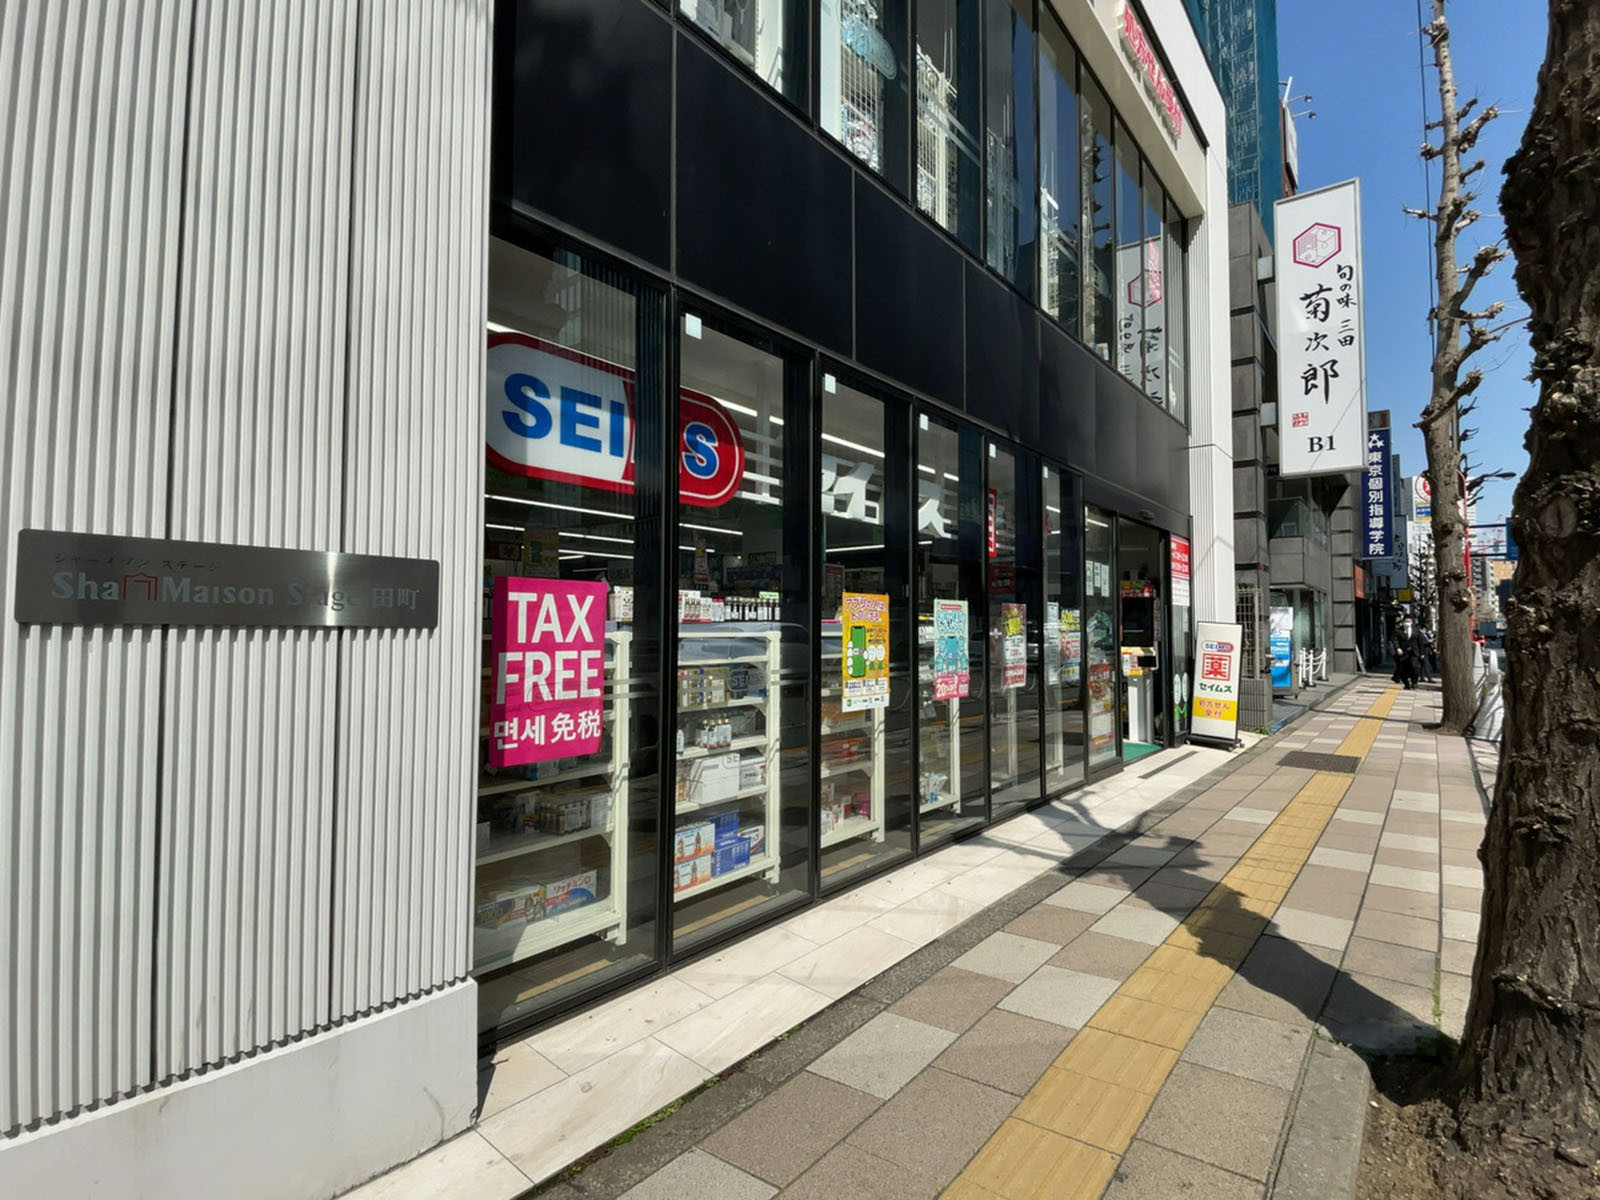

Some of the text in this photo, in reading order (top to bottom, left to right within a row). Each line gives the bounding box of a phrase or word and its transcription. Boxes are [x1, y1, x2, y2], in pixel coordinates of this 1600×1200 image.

[1336, 264, 1357, 348] 旬の味 三田
[1299, 283, 1340, 405] 菊次郎
[502, 372, 719, 479] SEIS
[1307, 434, 1336, 453] B1
[1368, 451, 1384, 555] 東京個別指導学院
[52, 571, 121, 601] Sha
[162, 575, 274, 606] Maison
[373, 587, 420, 611] 田町
[508, 592, 595, 644] TAX
[496, 650, 601, 705] FREE
[1199, 682, 1233, 693] セイムス
[1205, 656, 1228, 678] 薬
[494, 709, 601, 750] 면세 免税
